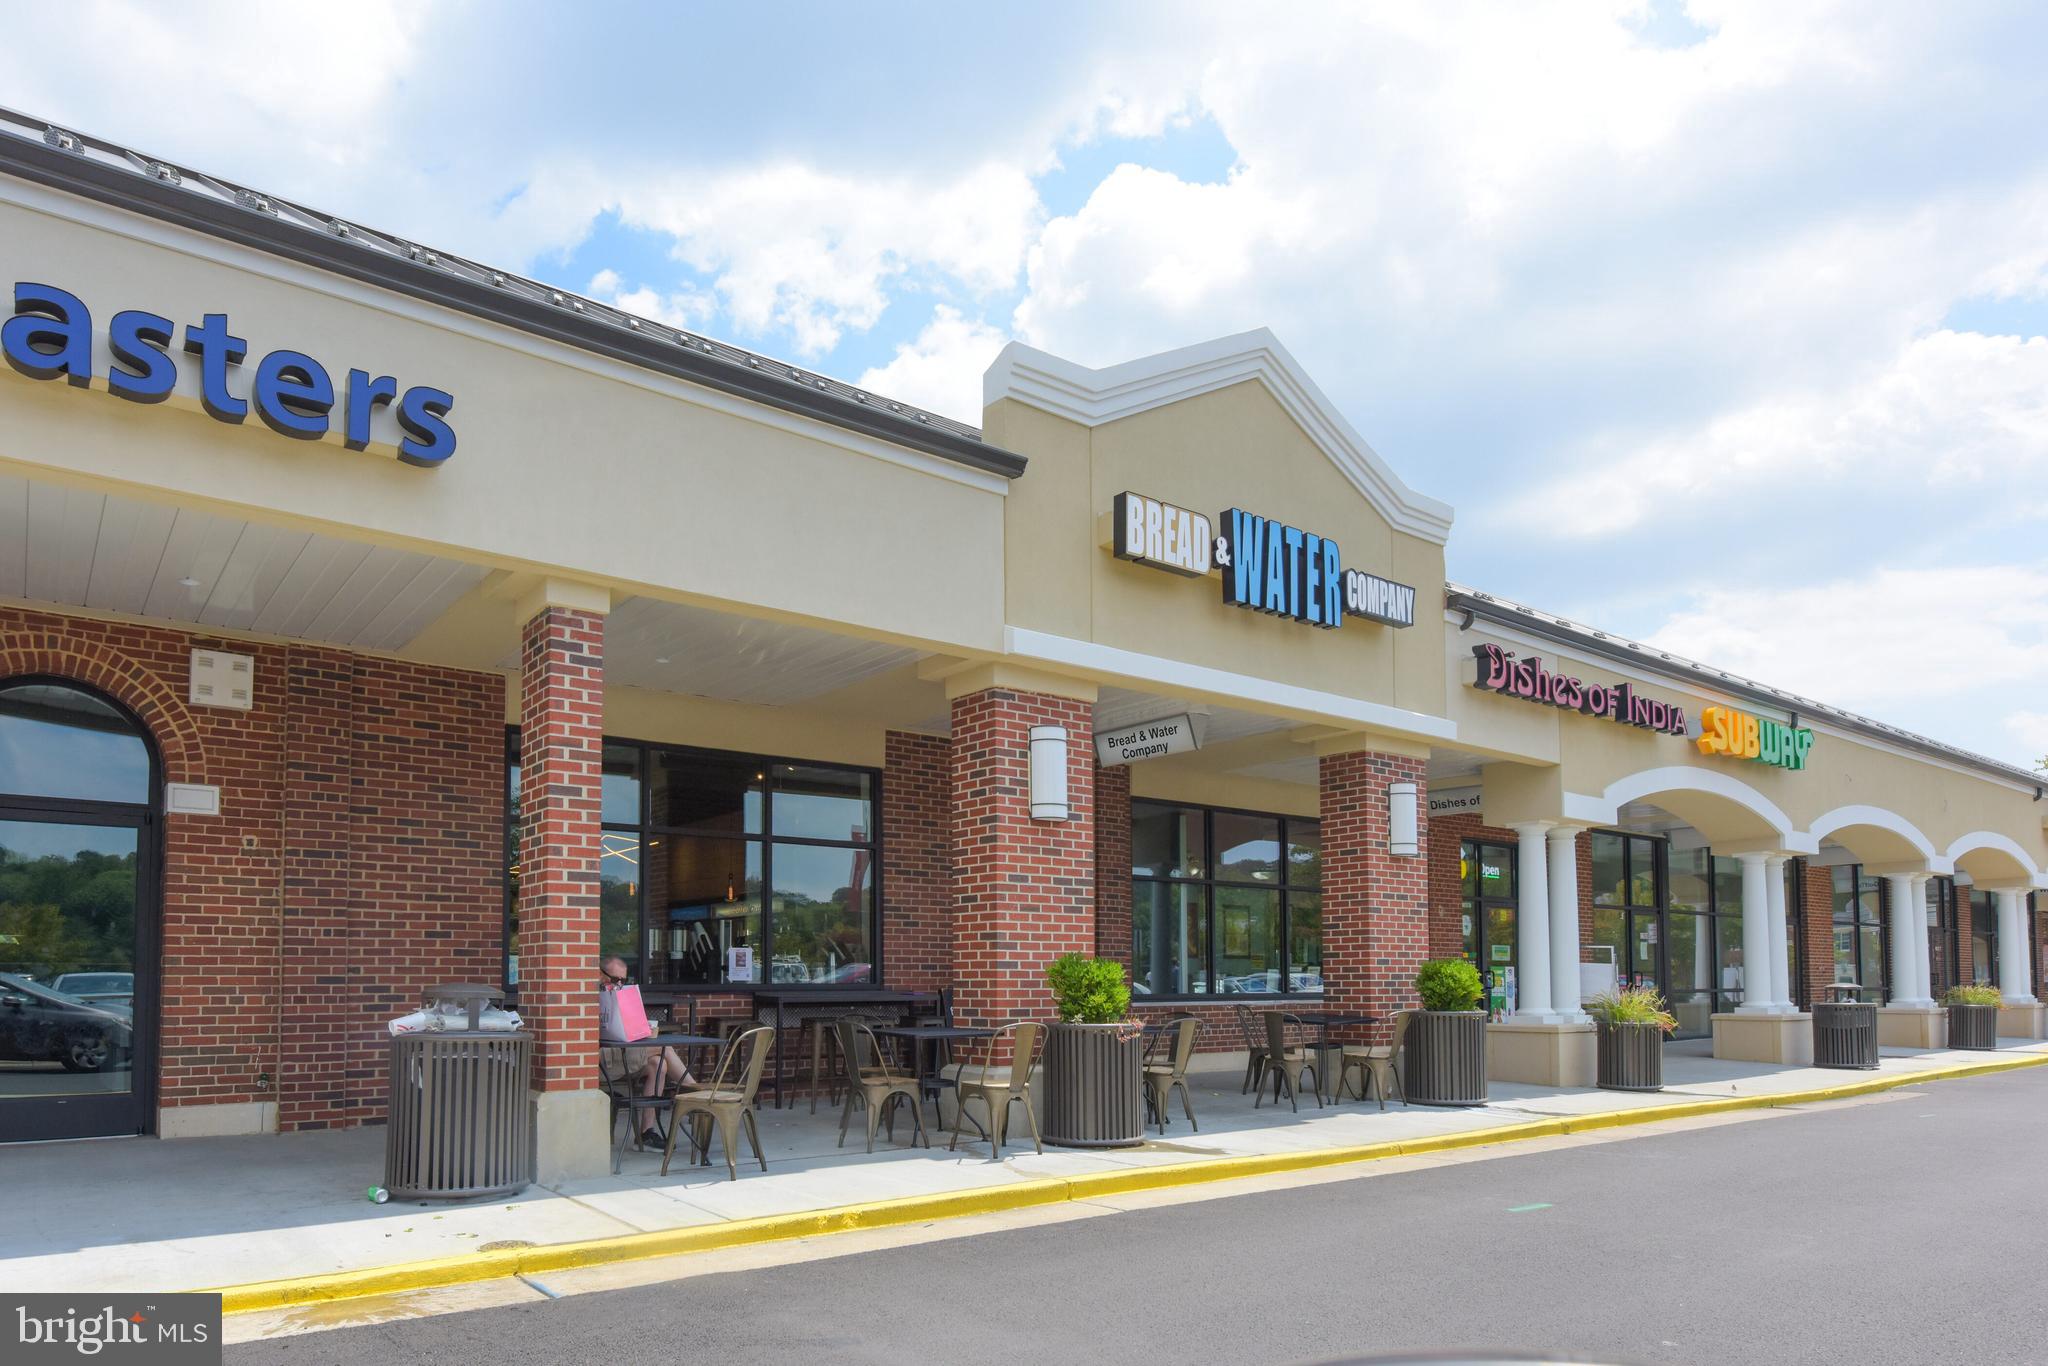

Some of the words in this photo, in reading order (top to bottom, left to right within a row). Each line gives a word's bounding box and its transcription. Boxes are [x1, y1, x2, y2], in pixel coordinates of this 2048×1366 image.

[1, 282, 458, 466] asters
[1125, 493, 1213, 576] BREAD
[1215, 536, 1232, 567] &
[1231, 507, 1342, 629] WATER
[1346, 569, 1415, 625] COMPANY
[1485, 642, 1583, 710] Dishes
[1107, 732, 1137, 749] Bread
[1139, 730, 1147, 742] &
[1148, 725, 1178, 740] Water
[1121, 742, 1169, 760] Company
[1697, 706, 1815, 770] SUBWAY
[1430, 798, 1467, 810] Dishes
[1469, 794, 1481, 806] of
